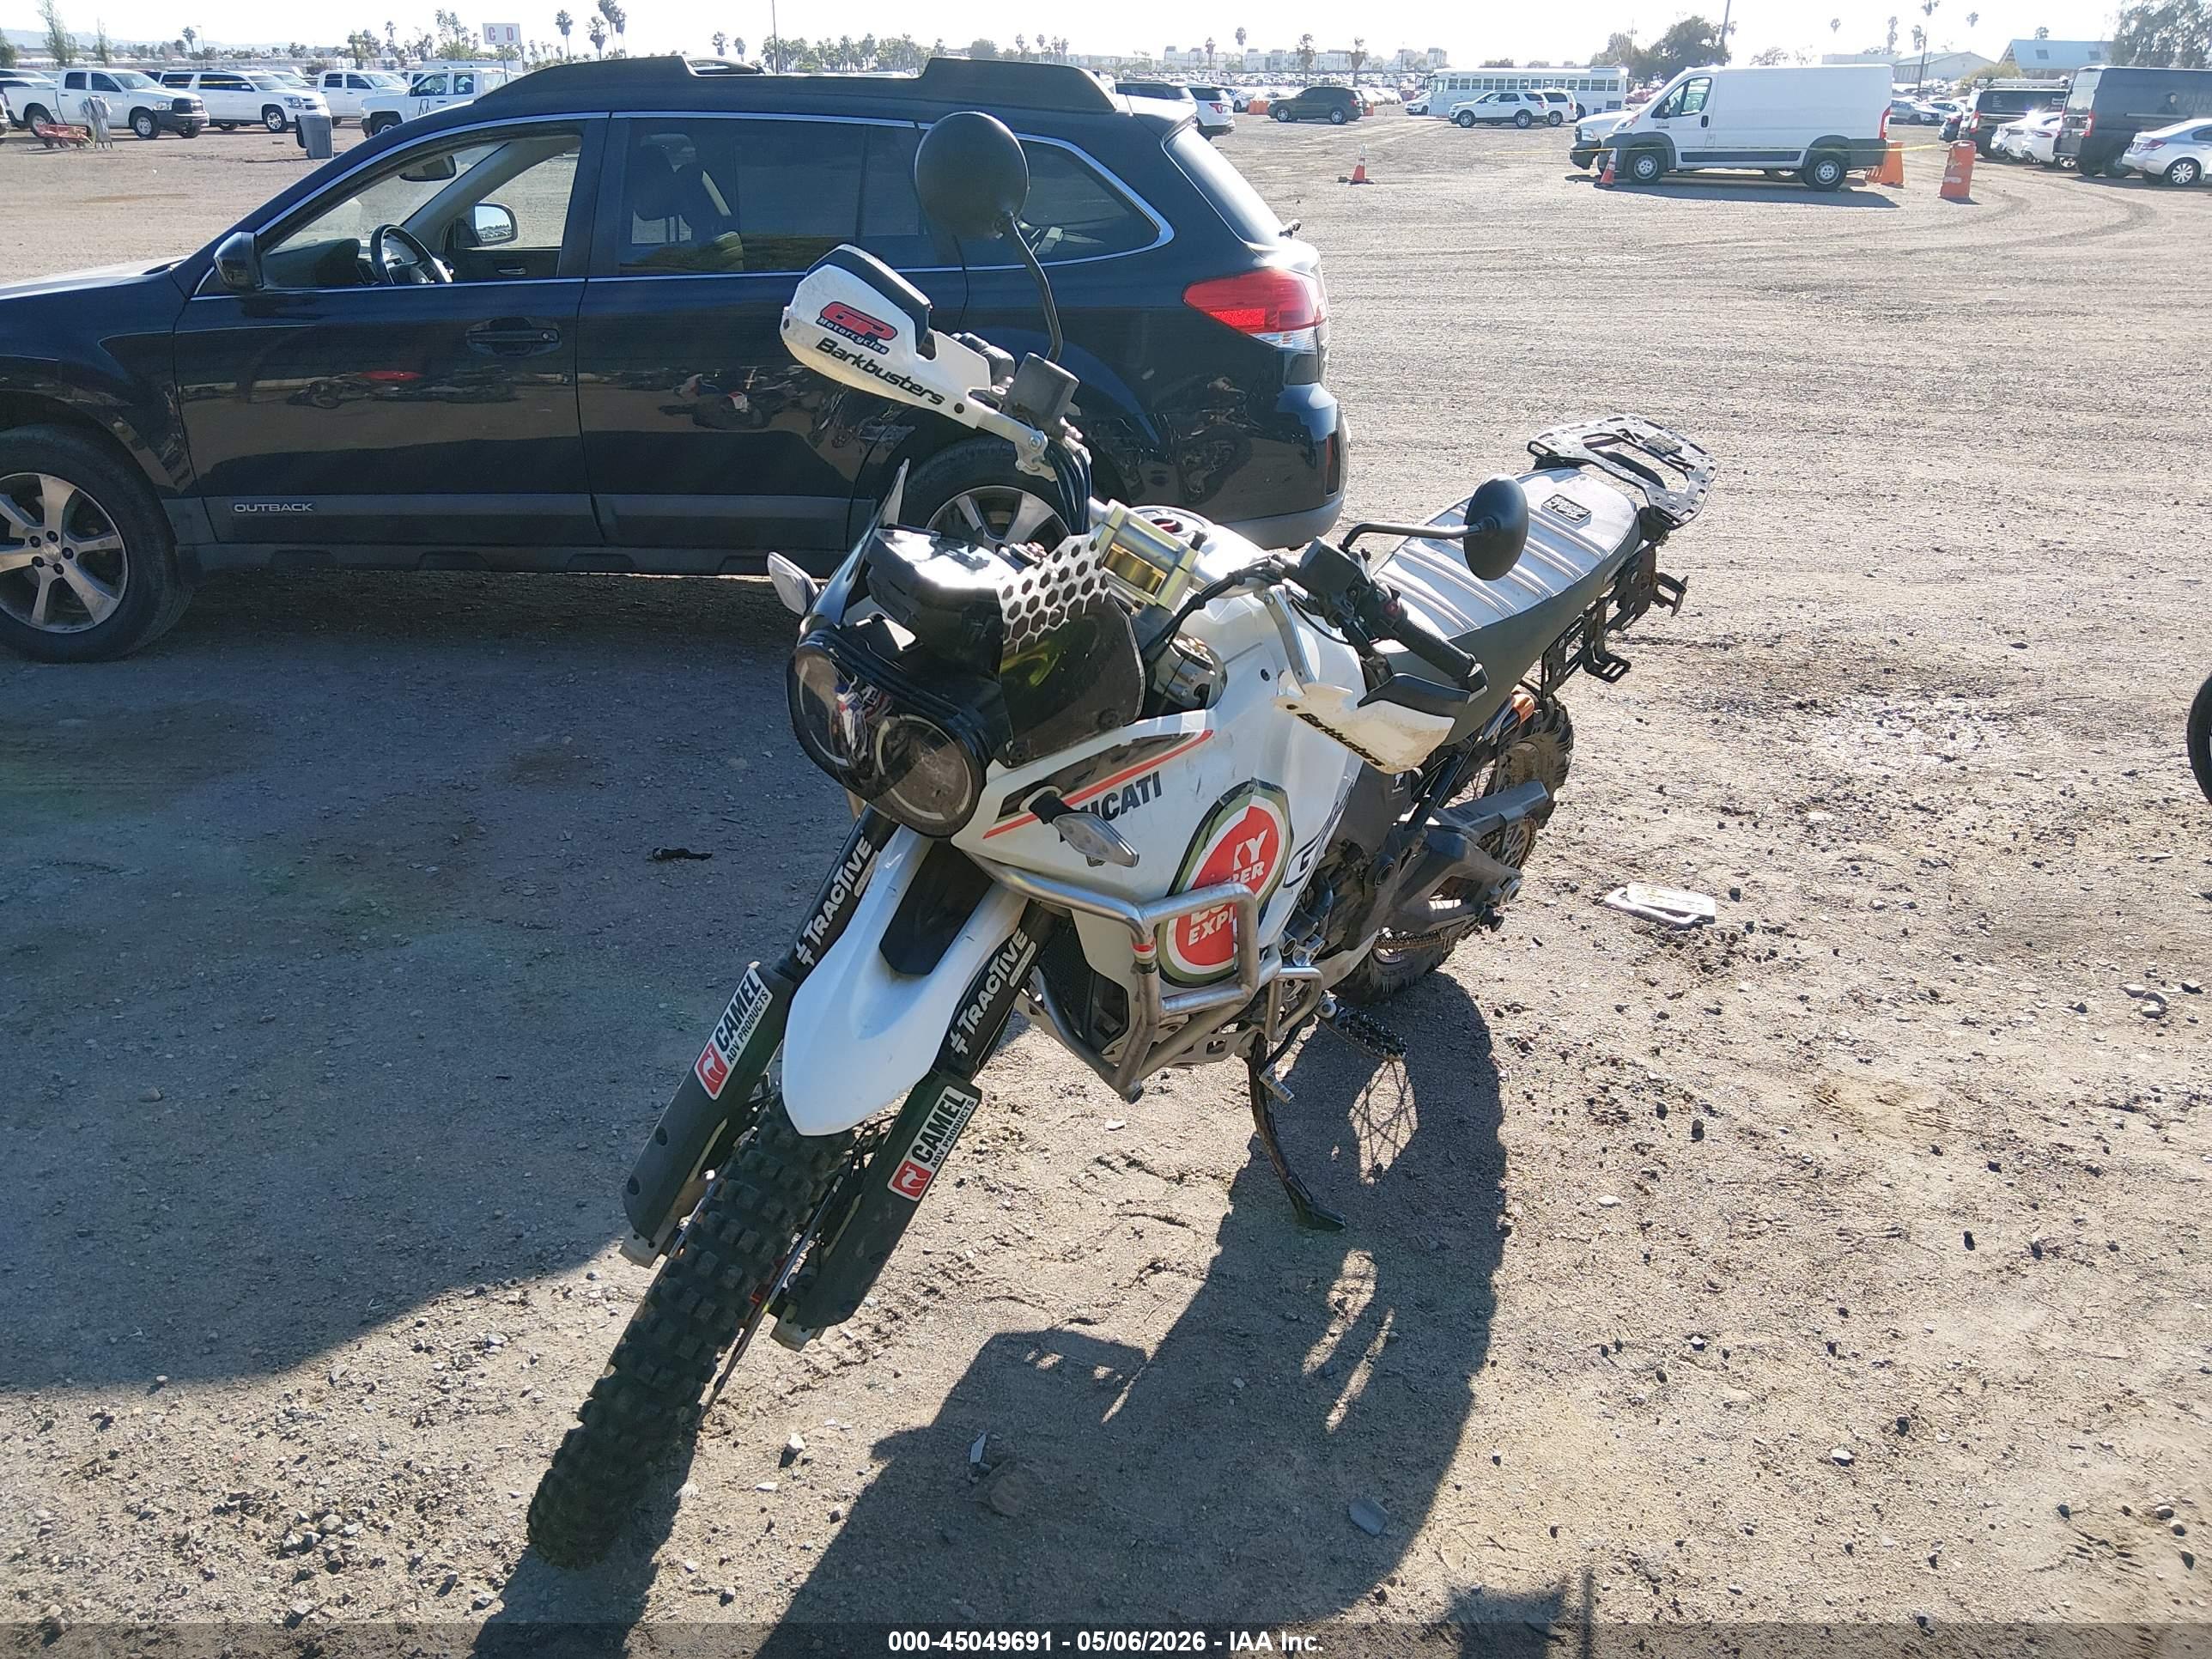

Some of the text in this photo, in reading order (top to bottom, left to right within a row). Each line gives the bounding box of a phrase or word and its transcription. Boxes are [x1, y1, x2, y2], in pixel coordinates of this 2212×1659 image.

[488, 27, 514, 41] C D
[817, 317, 889, 354] Motorcycles
[816, 337, 945, 405] Barkbusters
[234, 503, 313, 513] OUTBACK
[1079, 770, 1163, 822] CATI
[714, 974, 762, 1053] CAMEL
[726, 989, 769, 1065] ADV PRODUCTS
[911, 1092, 968, 1164] CAMEL
[930, 1099, 975, 1169] ADV PRODUCTS
